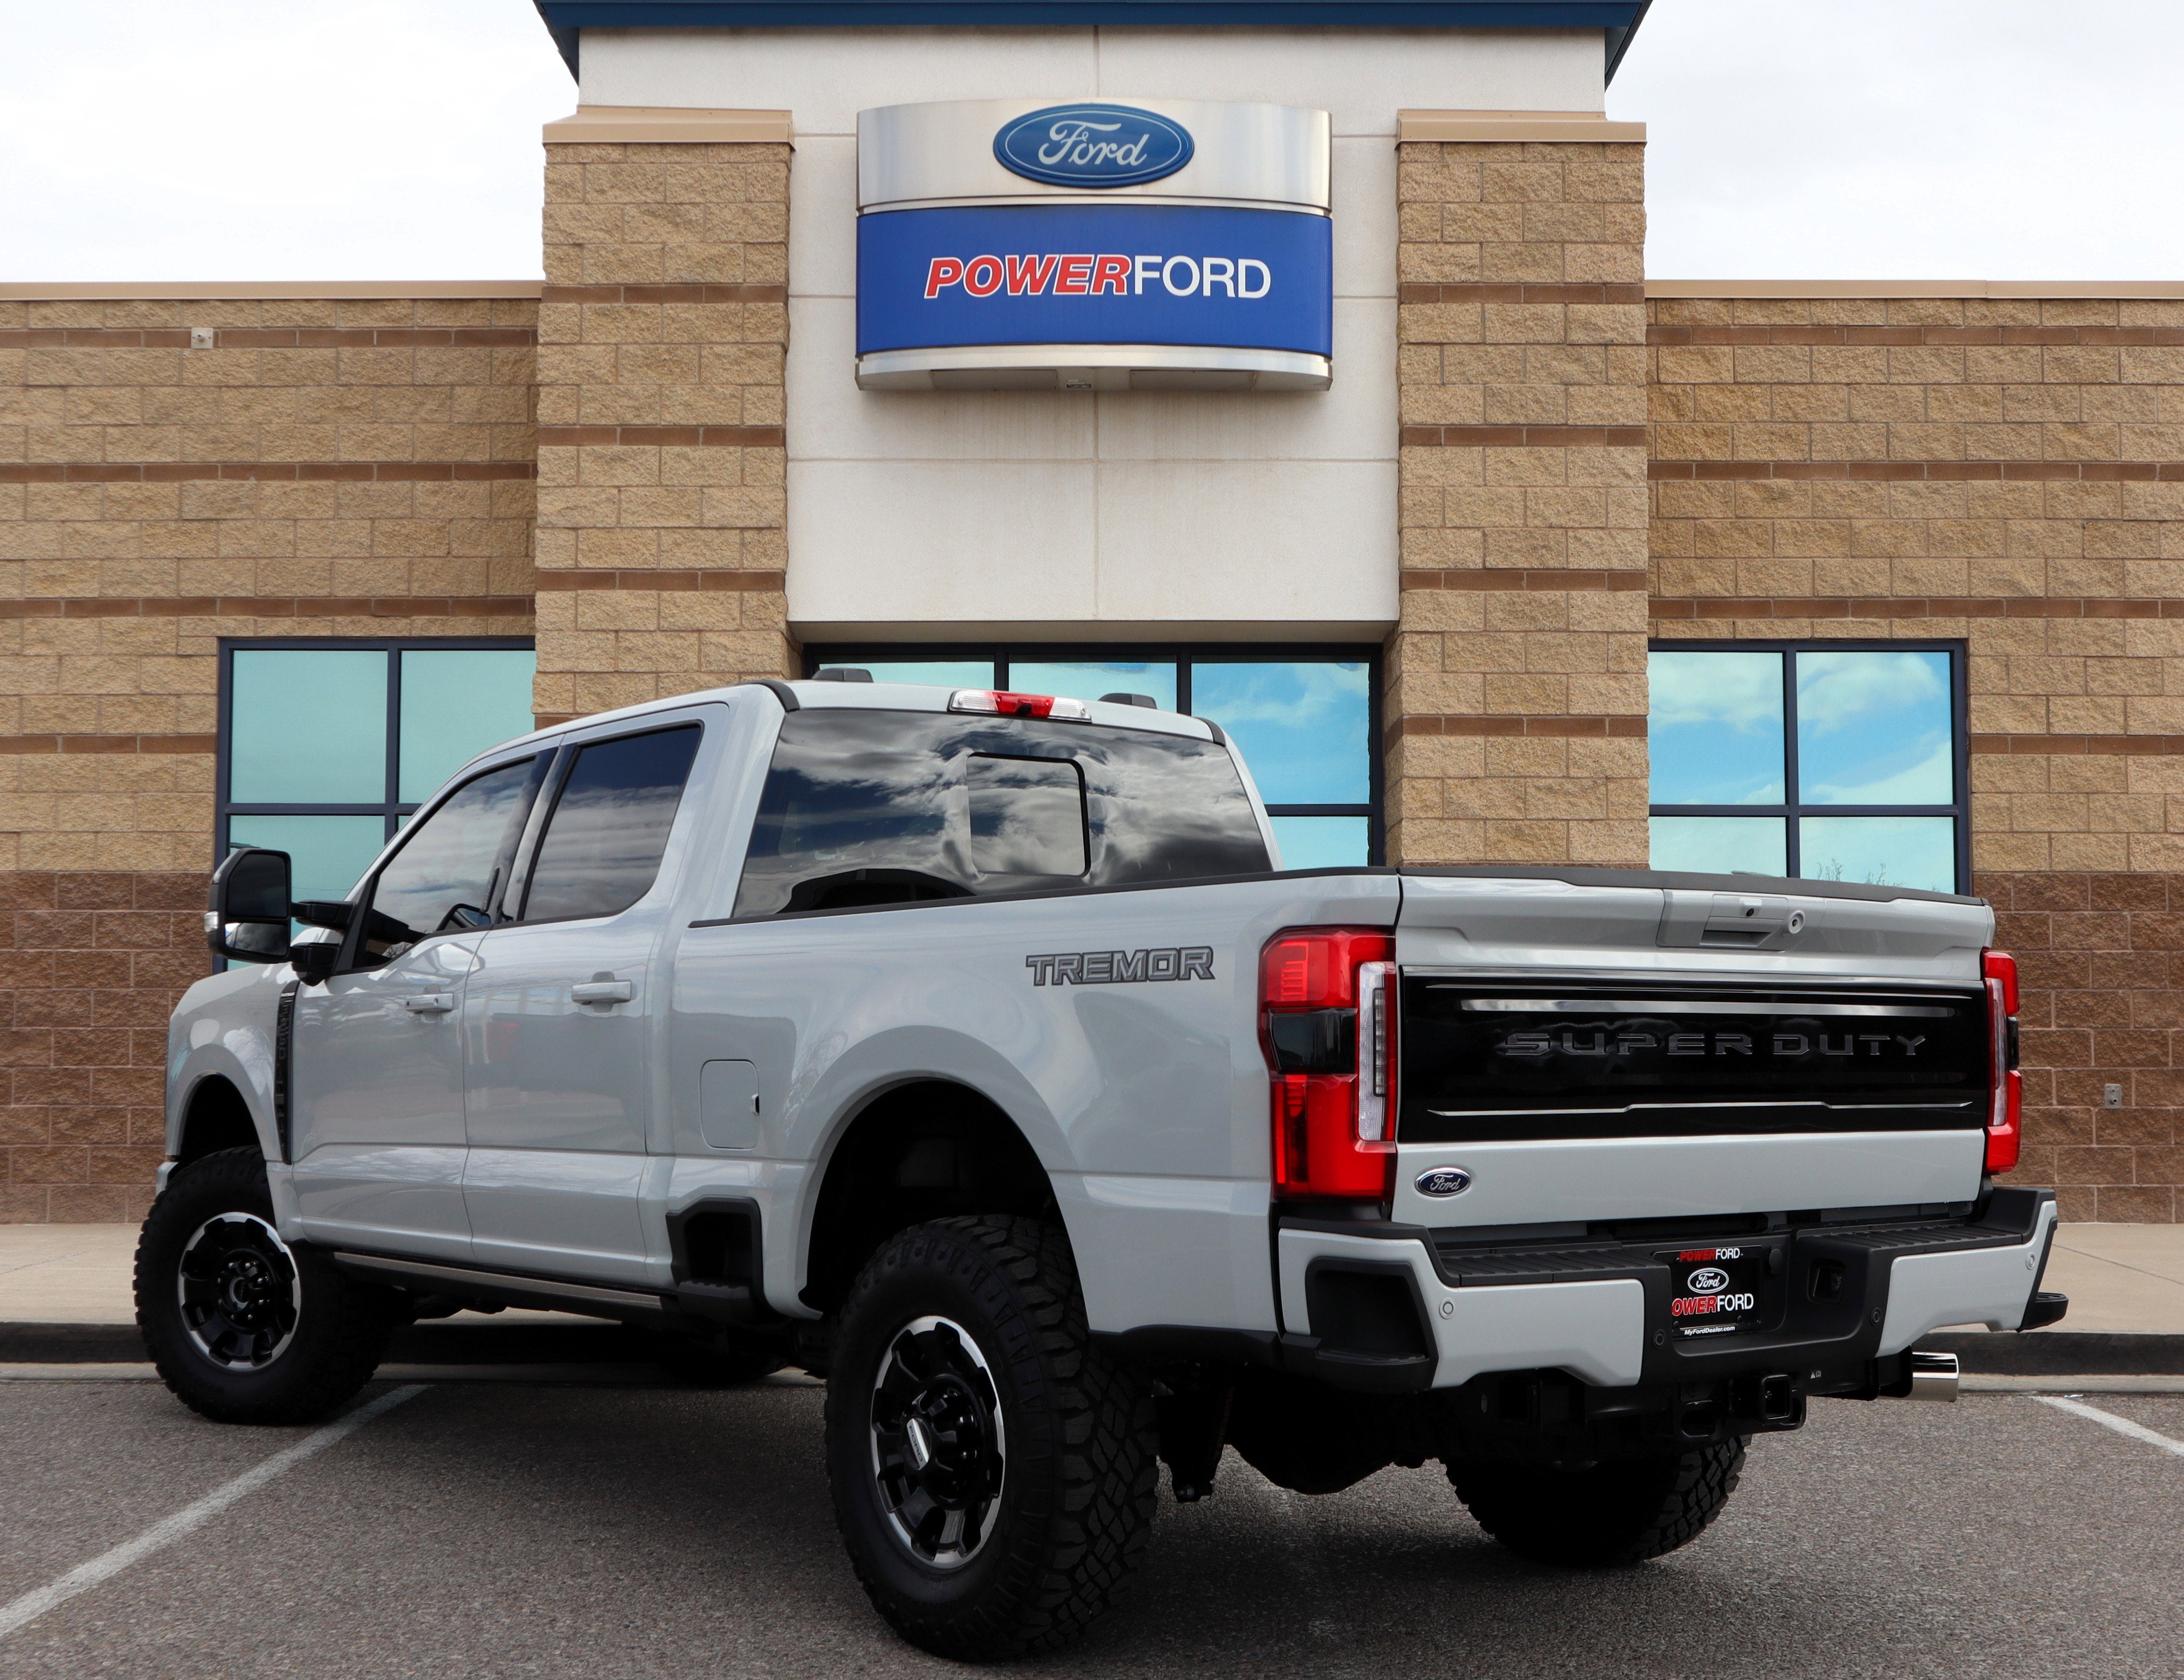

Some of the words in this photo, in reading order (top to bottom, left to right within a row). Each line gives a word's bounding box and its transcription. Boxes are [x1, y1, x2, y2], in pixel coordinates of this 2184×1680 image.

[1038, 120, 1150, 167] Ford
[1025, 945, 1216, 986] TREMOR
[1505, 1032, 1753, 1056] SUPER
[1772, 1033, 1926, 1056] DUTY
[1430, 1174, 1461, 1191] Ford
[1696, 1272, 1720, 1288] Ford
[1672, 1293, 1754, 1317] OWERFORD
[1684, 1325, 1736, 1336] MyFordDealer.com
[909, 1425, 923, 1462] FORD
